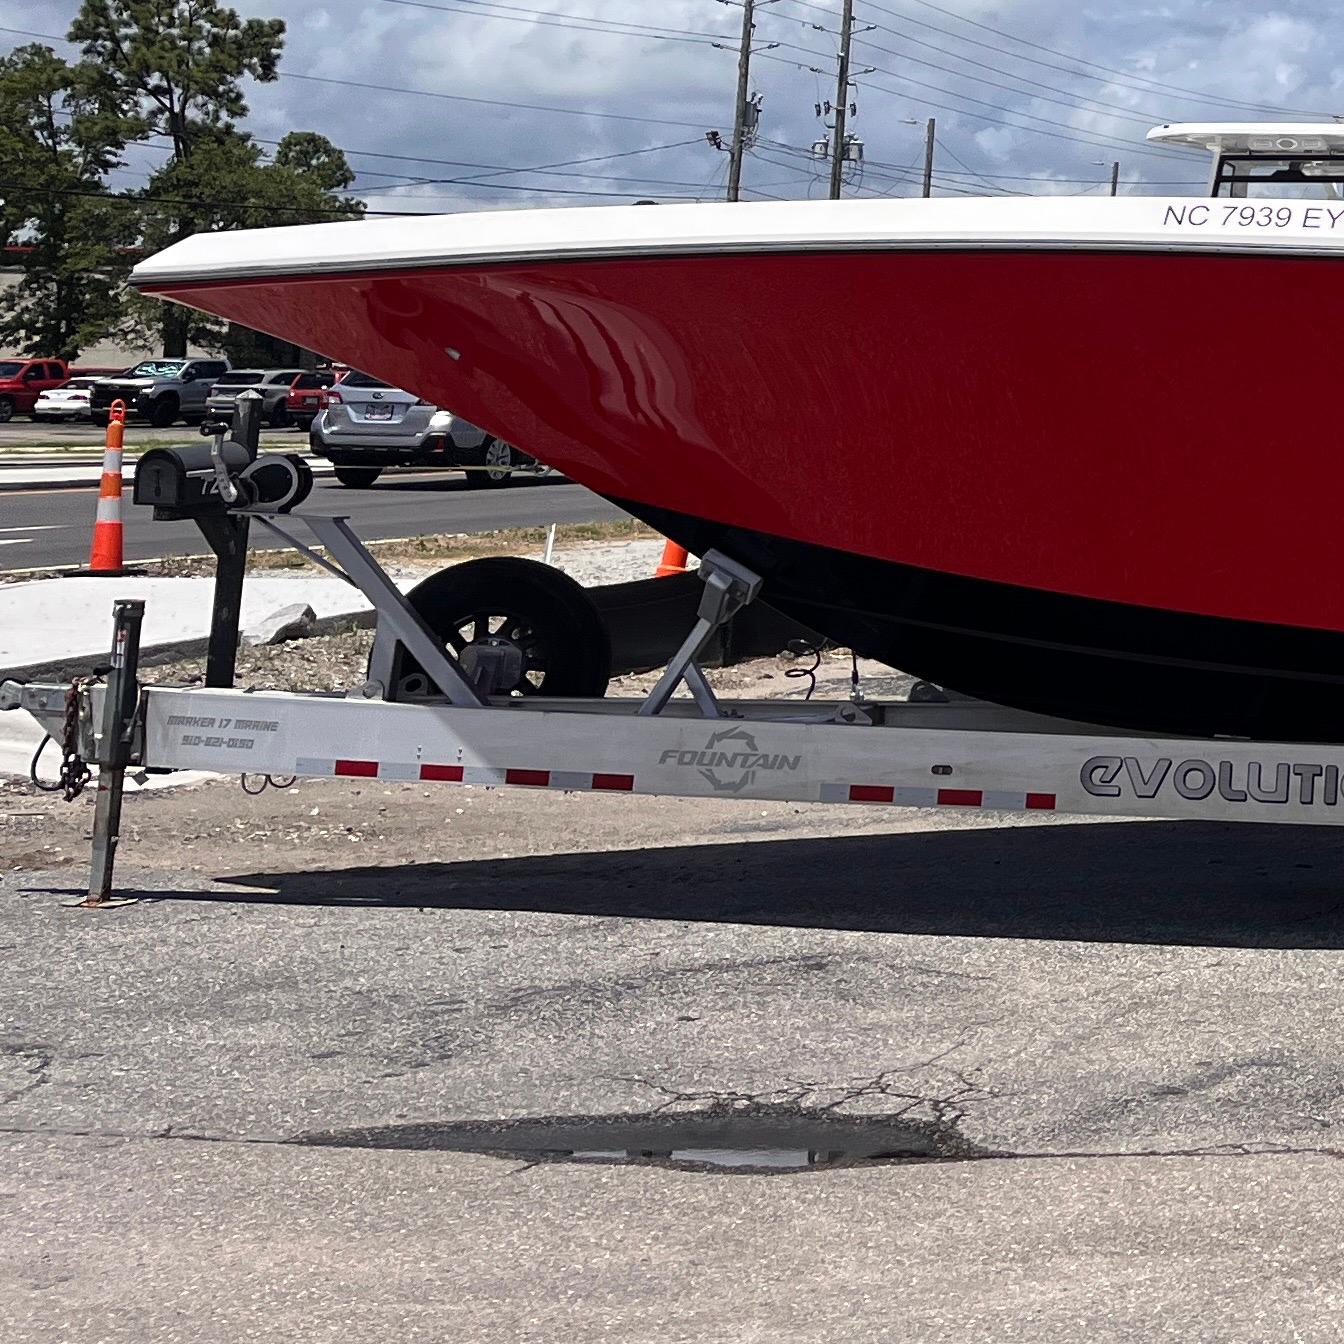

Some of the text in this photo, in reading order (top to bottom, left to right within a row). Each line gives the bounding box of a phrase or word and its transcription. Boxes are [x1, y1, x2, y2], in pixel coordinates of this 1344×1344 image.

[1163, 205, 1210, 227] NC
[1220, 206, 1292, 228] 7939
[218, 718, 232, 729] 17
[658, 749, 803, 771] FOUNTAIN
